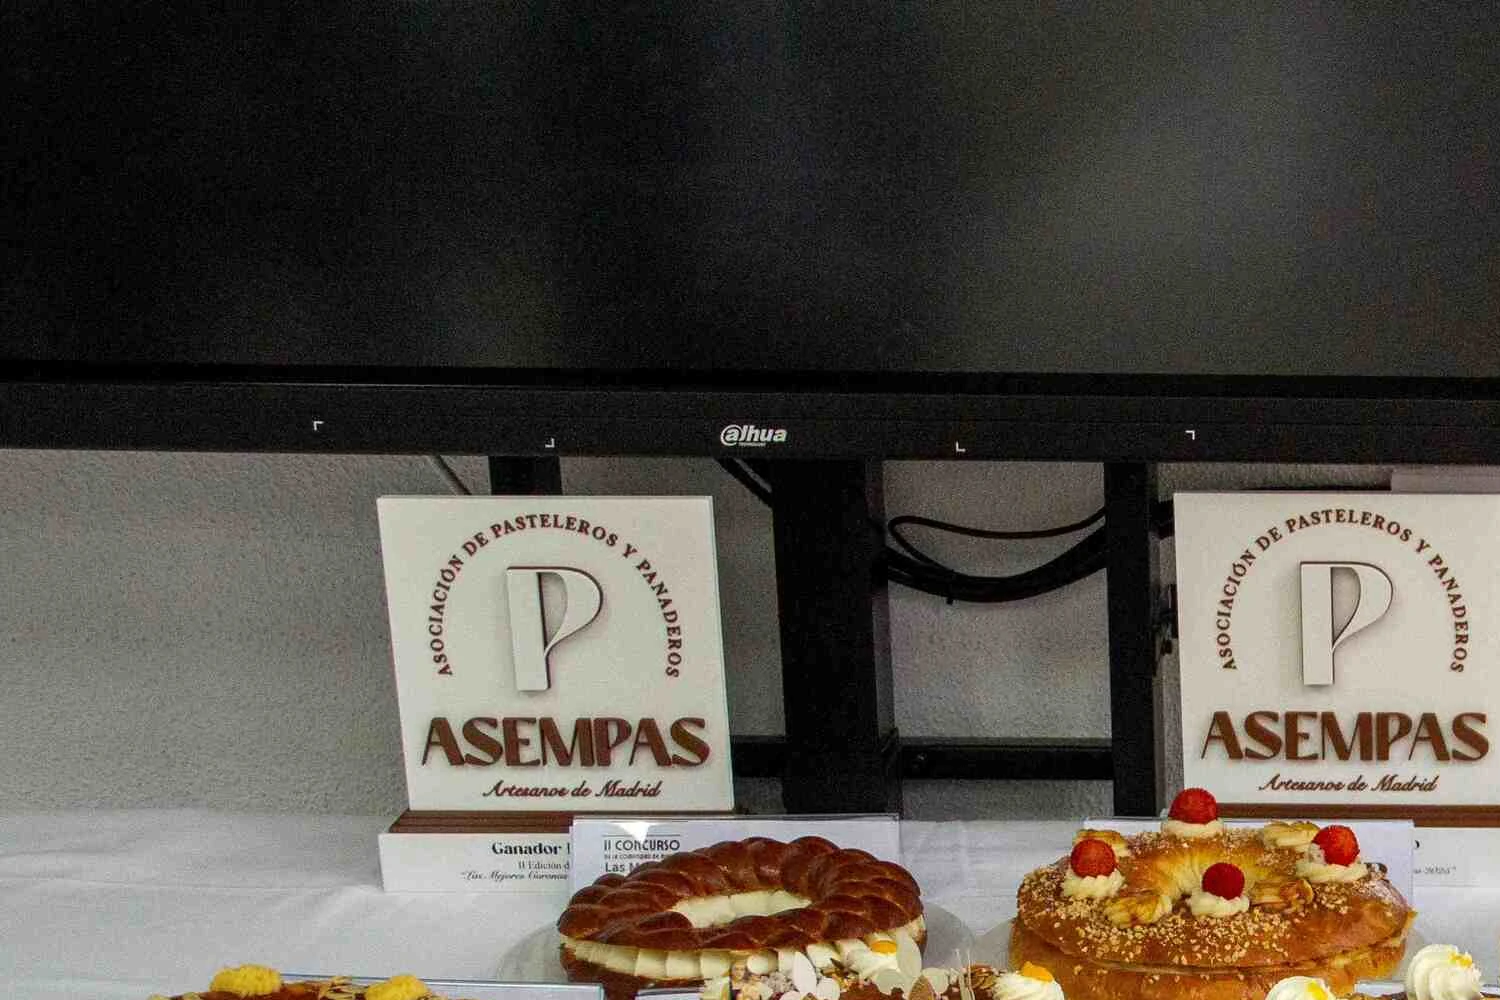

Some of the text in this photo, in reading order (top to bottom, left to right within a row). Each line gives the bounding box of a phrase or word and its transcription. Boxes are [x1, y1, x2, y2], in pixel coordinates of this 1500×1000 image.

[429, 514, 683, 678] ASOCIACIÓN DE PASTELEROS Y PANADEROS
[1216, 509, 1470, 673] ASOCIACIÓN DE PASTELEROS Y PANADEROS
[506, 565, 604, 691] P
[1300, 561, 1394, 685] P
[421, 717, 710, 767] ASEMPAS
[1201, 711, 1490, 761] ASEMPAS
[482, 780, 664, 798] Artesanos de Madrid
[1258, 774, 1440, 792] Artesanos de Madrid
[491, 842, 562, 855] Ganador
[605, 862, 626, 873] Las
[615, 839, 681, 851] CONCURSO
